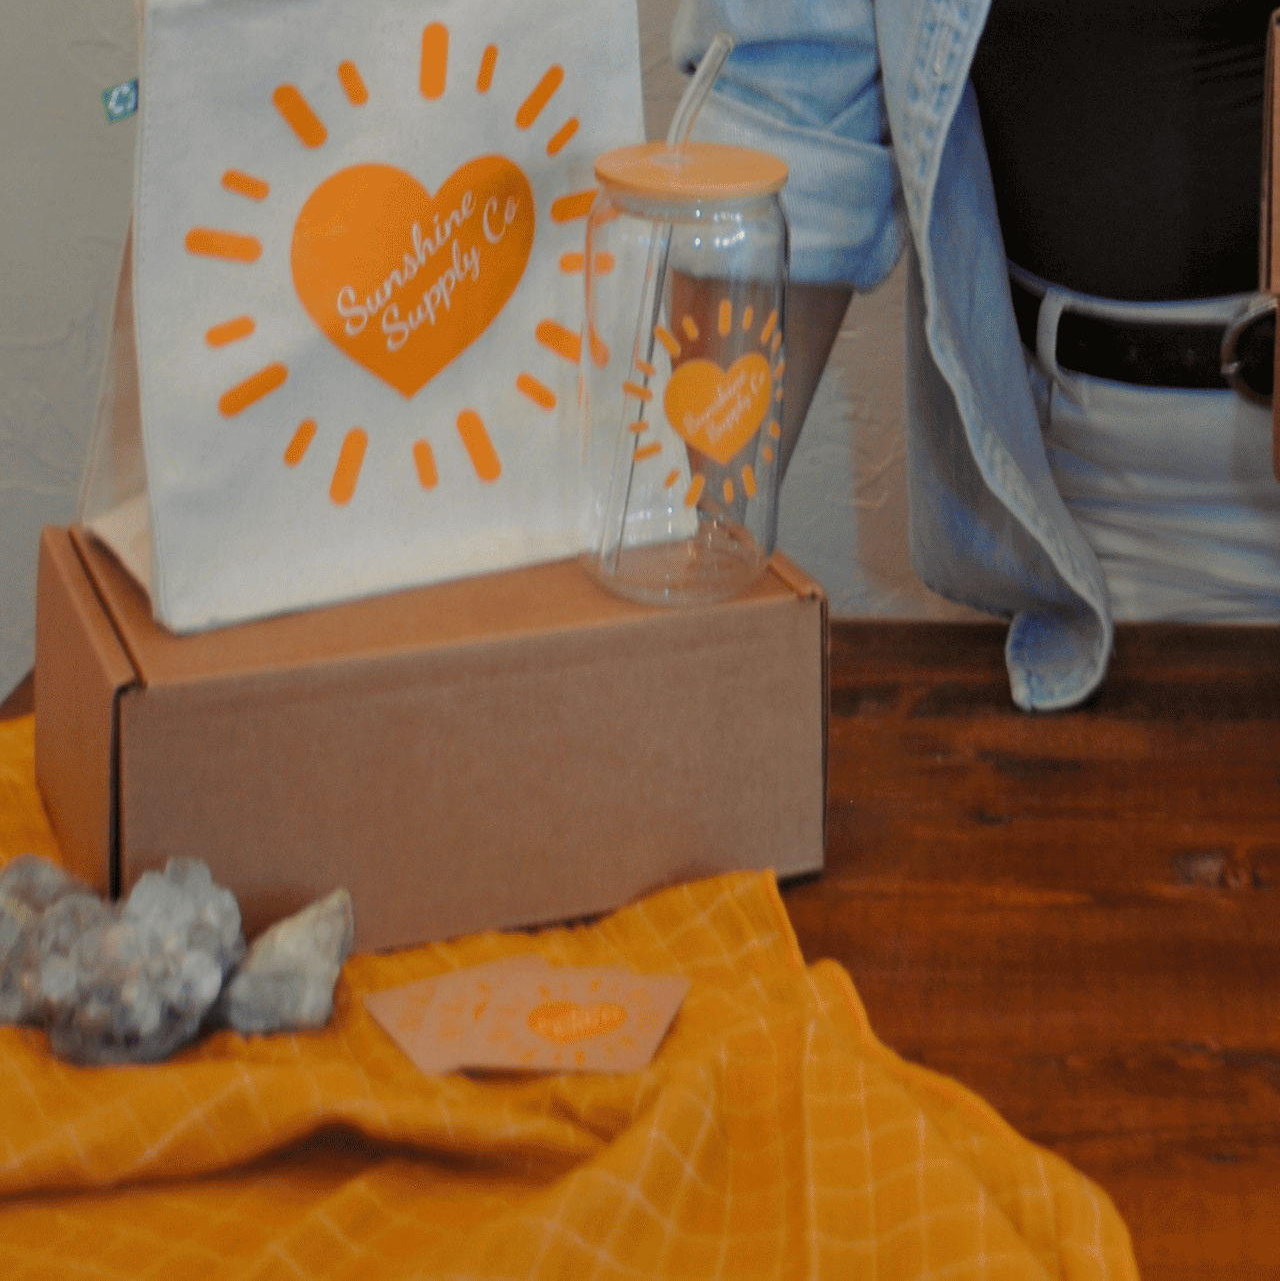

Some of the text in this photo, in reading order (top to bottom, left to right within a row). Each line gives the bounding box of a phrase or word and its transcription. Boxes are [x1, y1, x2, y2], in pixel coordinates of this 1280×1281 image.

[336, 189, 477, 338] Sunshine
[381, 195, 520, 354] Supply Co
